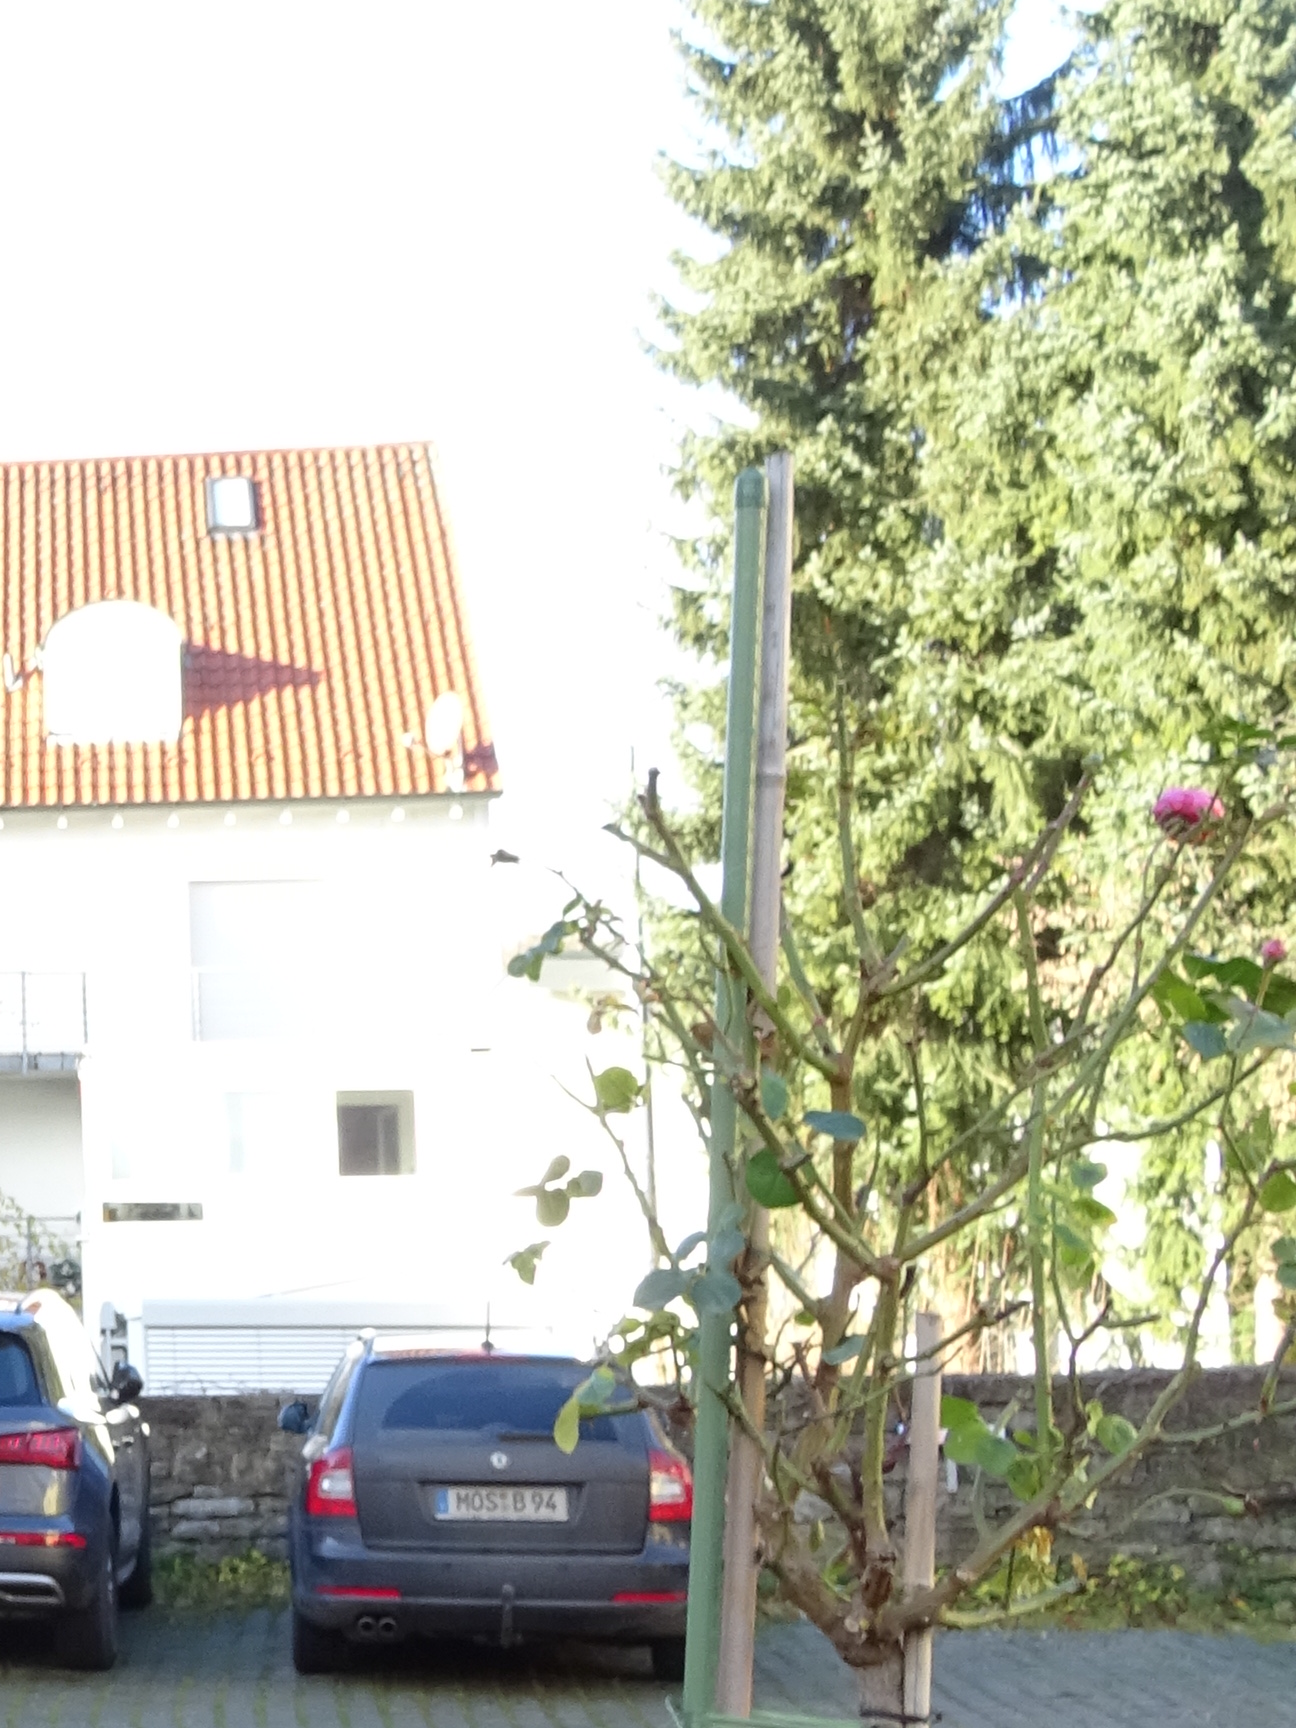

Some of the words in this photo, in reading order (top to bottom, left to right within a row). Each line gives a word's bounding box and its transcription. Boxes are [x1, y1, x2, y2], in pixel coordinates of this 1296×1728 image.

[455, 1490, 499, 1513] MOS
[512, 1490, 527, 1513] B
[532, 1491, 558, 1513] 94
